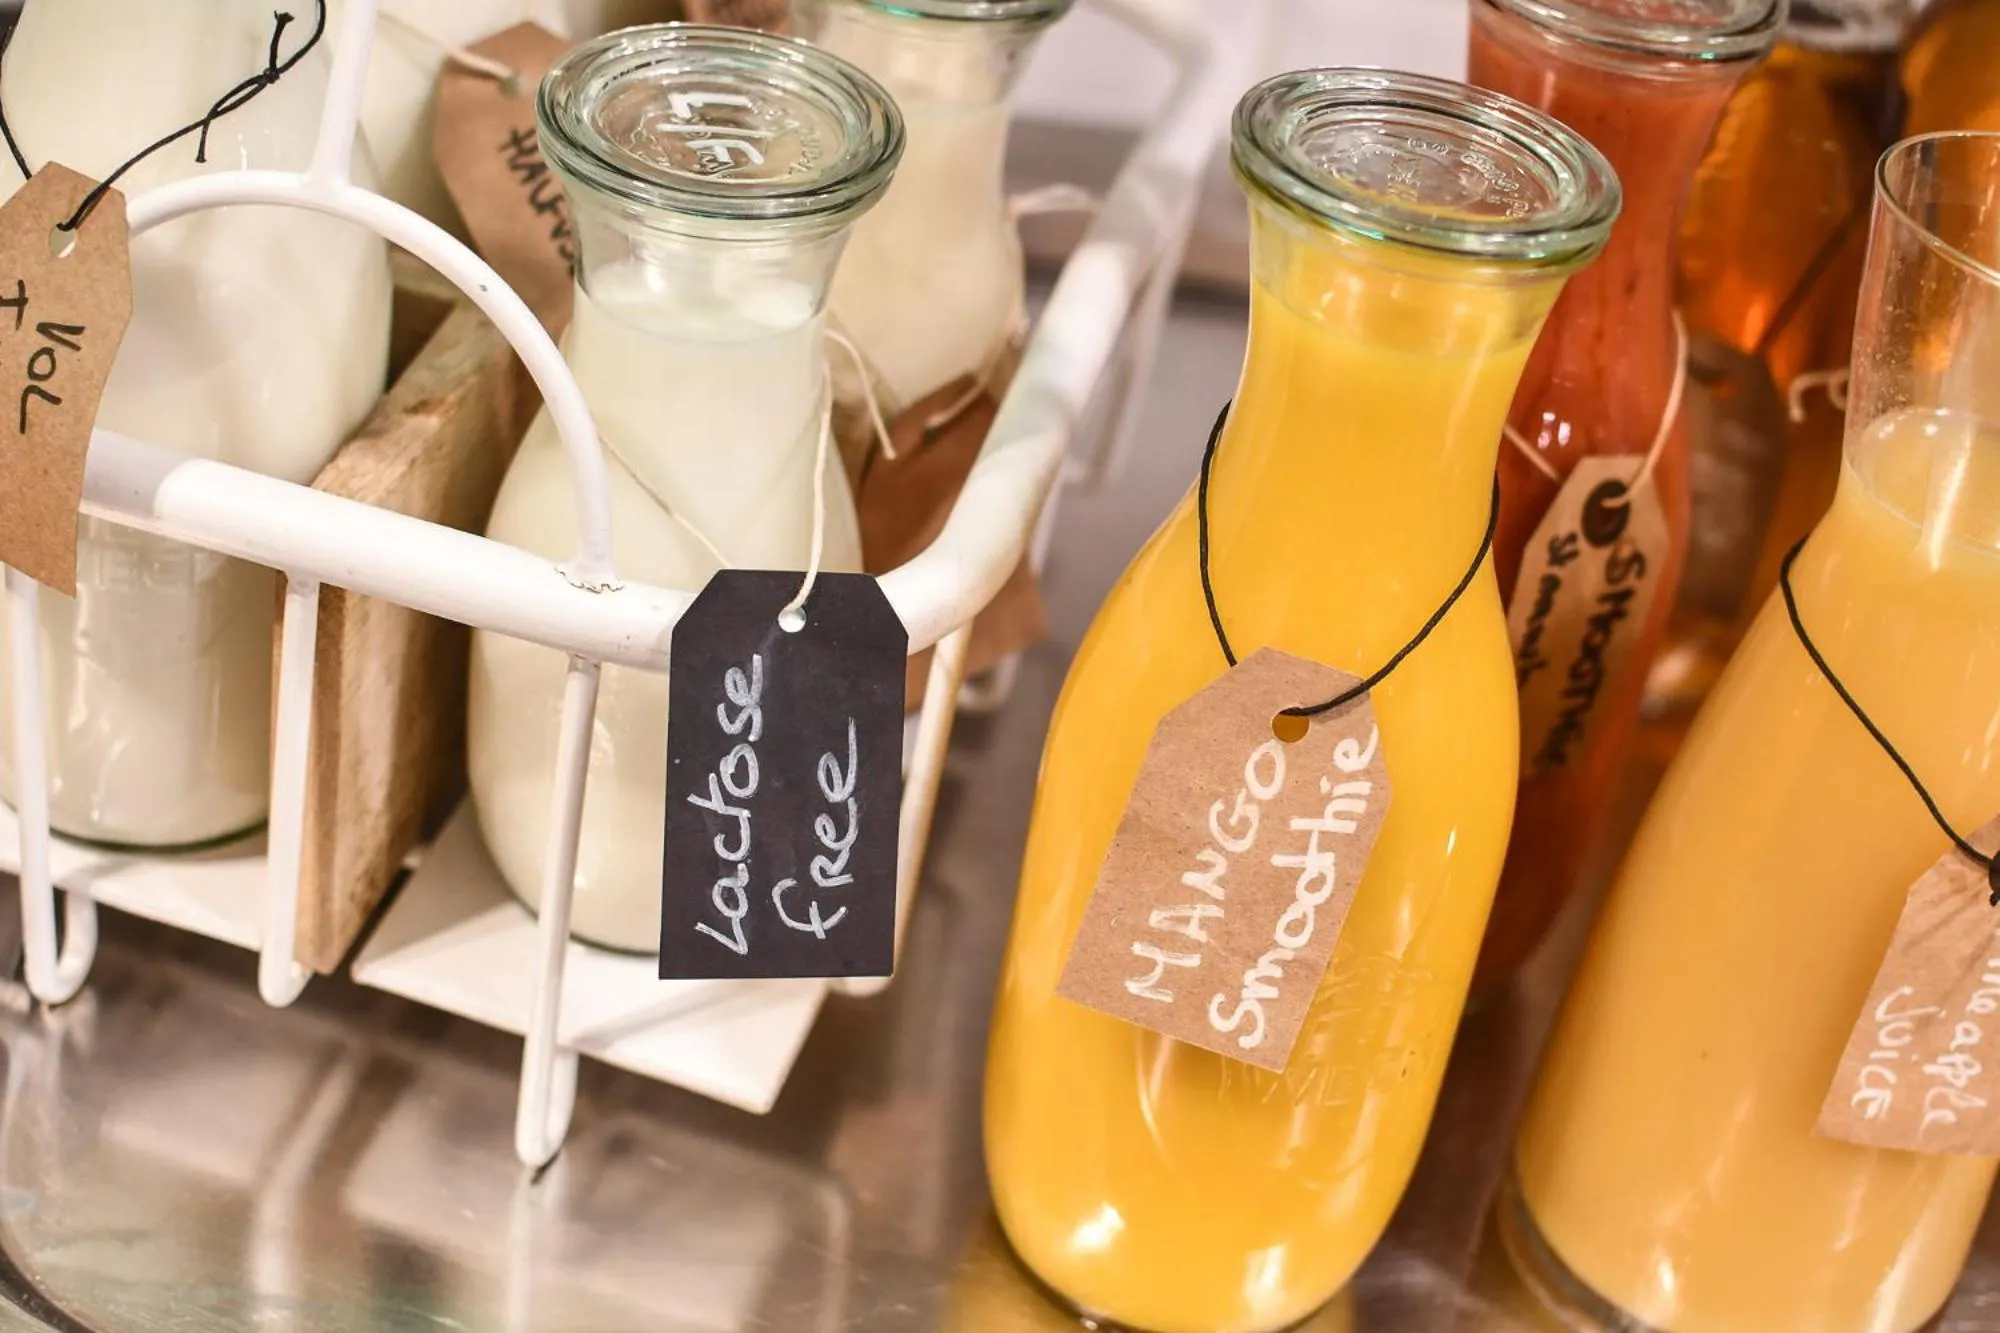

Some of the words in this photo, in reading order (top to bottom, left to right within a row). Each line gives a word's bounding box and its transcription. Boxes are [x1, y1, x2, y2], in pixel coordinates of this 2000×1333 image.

[20, 321, 85, 435] VOL
[687, 653, 763, 955] Lactose
[1124, 740, 1285, 1004] MANGO
[1208, 724, 1379, 1050] Smoothie
